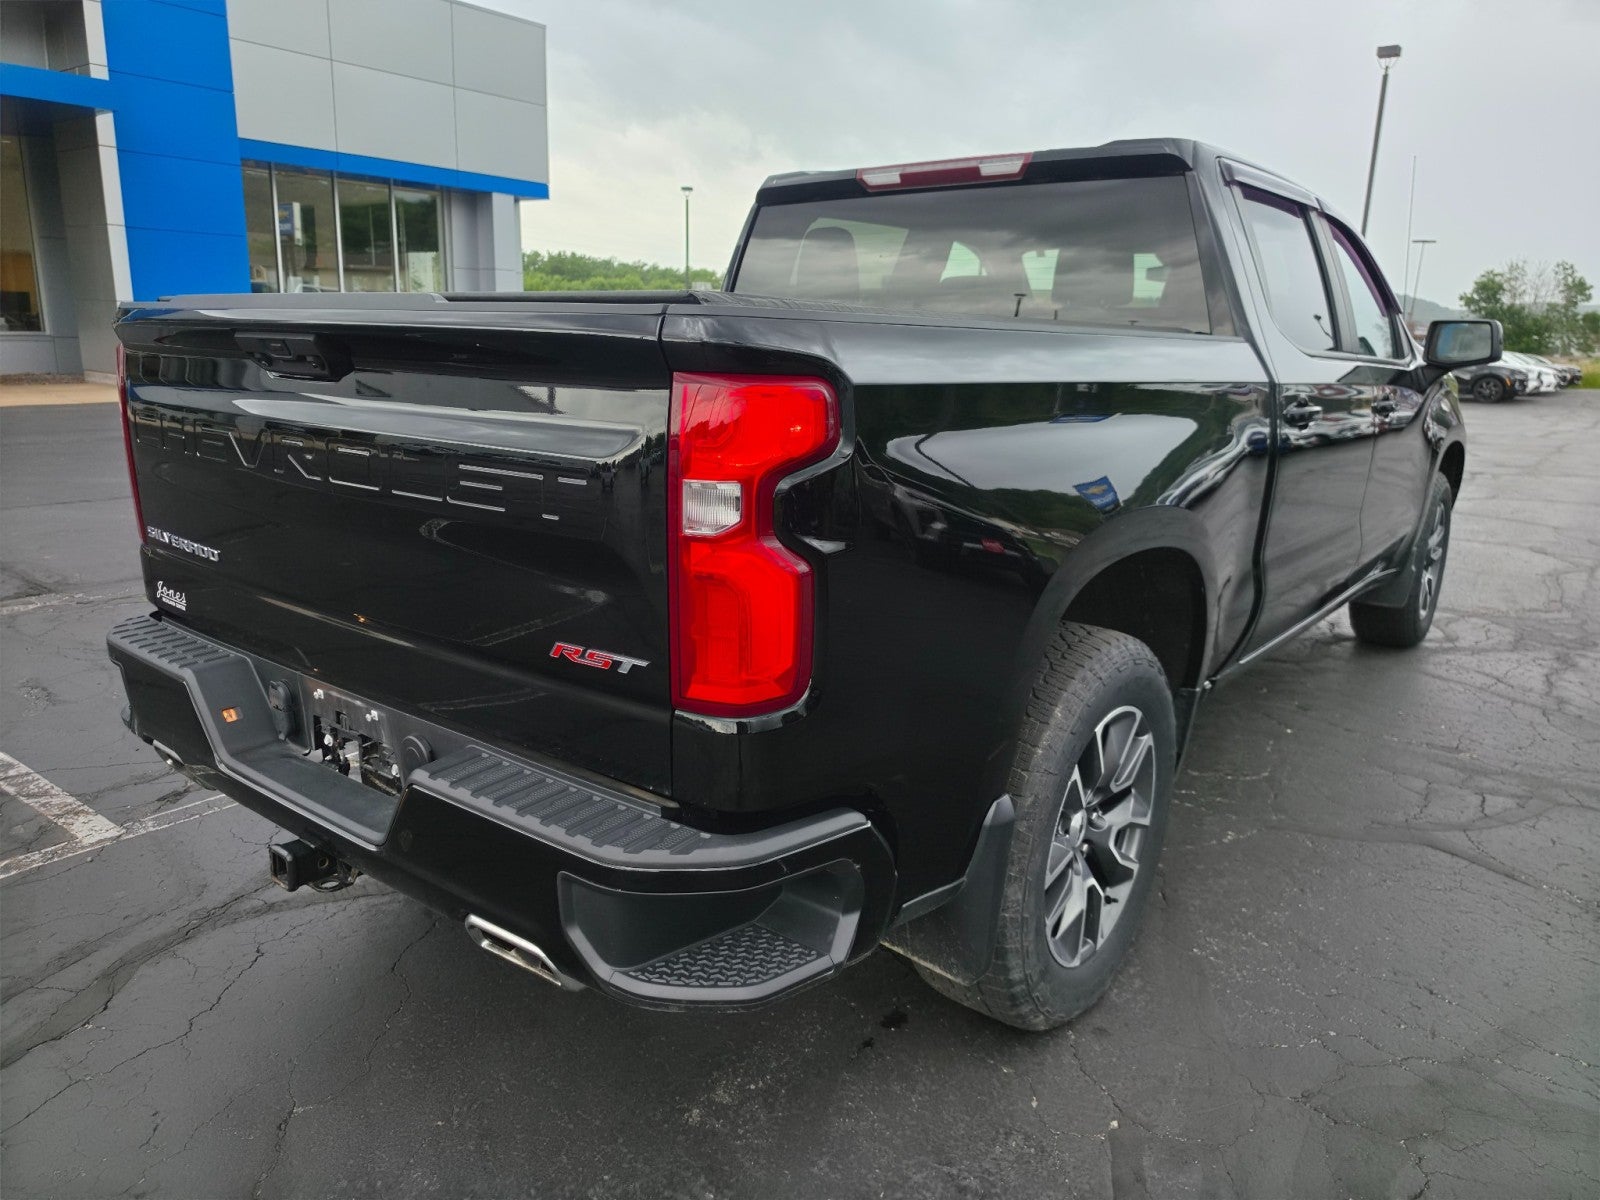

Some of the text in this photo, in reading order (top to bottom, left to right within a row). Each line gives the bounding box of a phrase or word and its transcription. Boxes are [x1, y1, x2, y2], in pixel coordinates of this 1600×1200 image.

[134, 407, 589, 519] CHEVROLET
[147, 526, 220, 562] SILVERADO
[157, 581, 186, 603] Jones
[549, 642, 651, 674] RST
